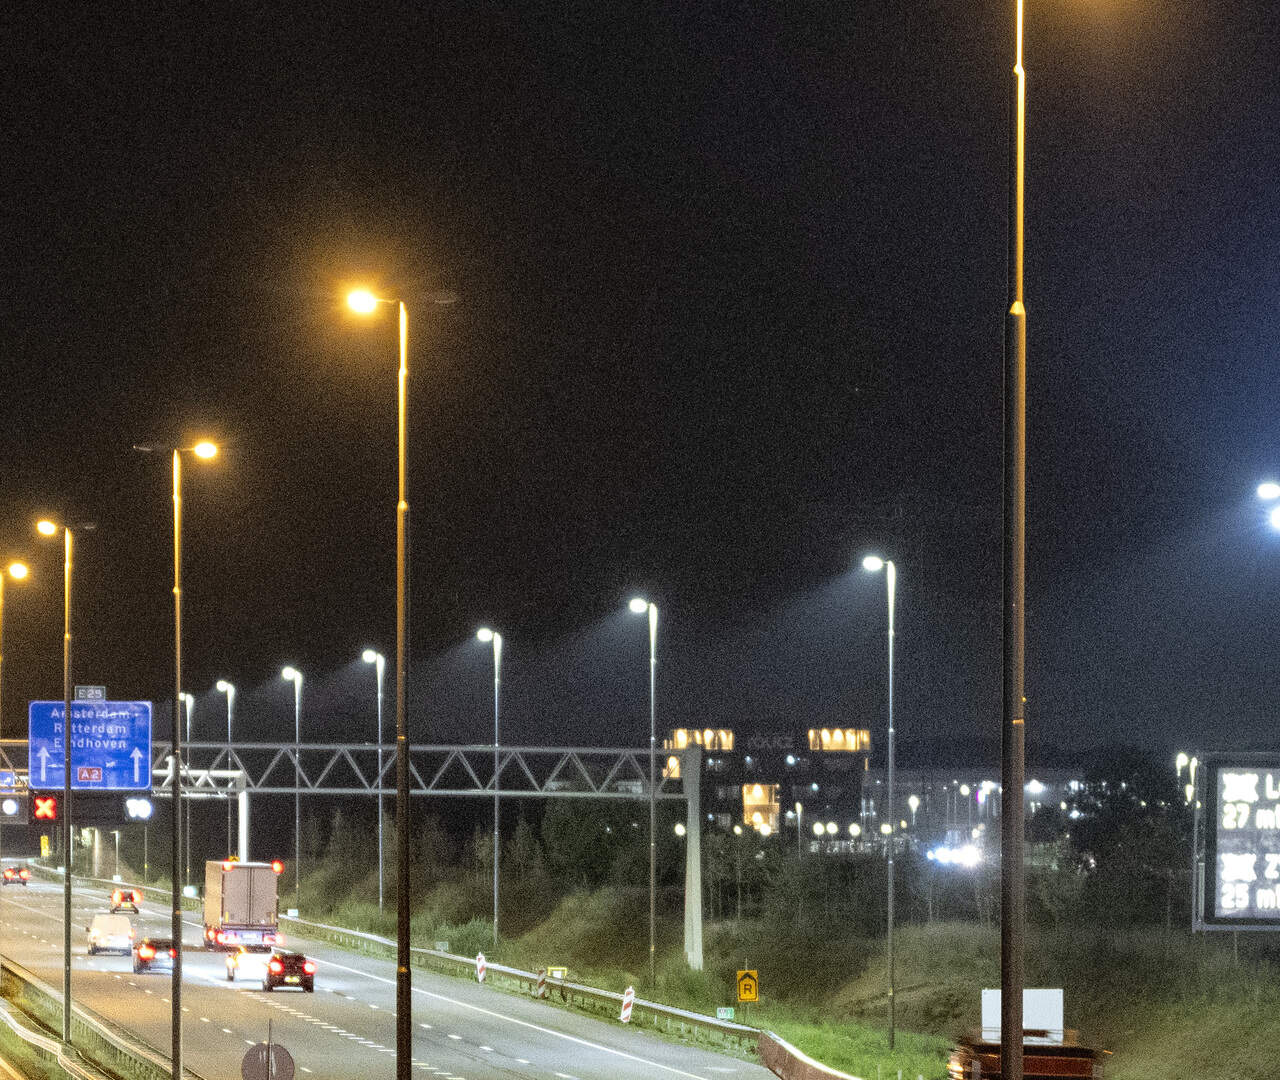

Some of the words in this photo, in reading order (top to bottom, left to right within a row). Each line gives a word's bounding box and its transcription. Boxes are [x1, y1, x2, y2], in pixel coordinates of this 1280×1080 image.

[54, 722, 126, 734] Rtterdam
[54, 737, 128, 749] Endhoven
[81, 769, 99, 780] A2
[1222, 802, 1250, 830] 27
[1221, 882, 1250, 910] 25
[744, 984, 753, 994] R
